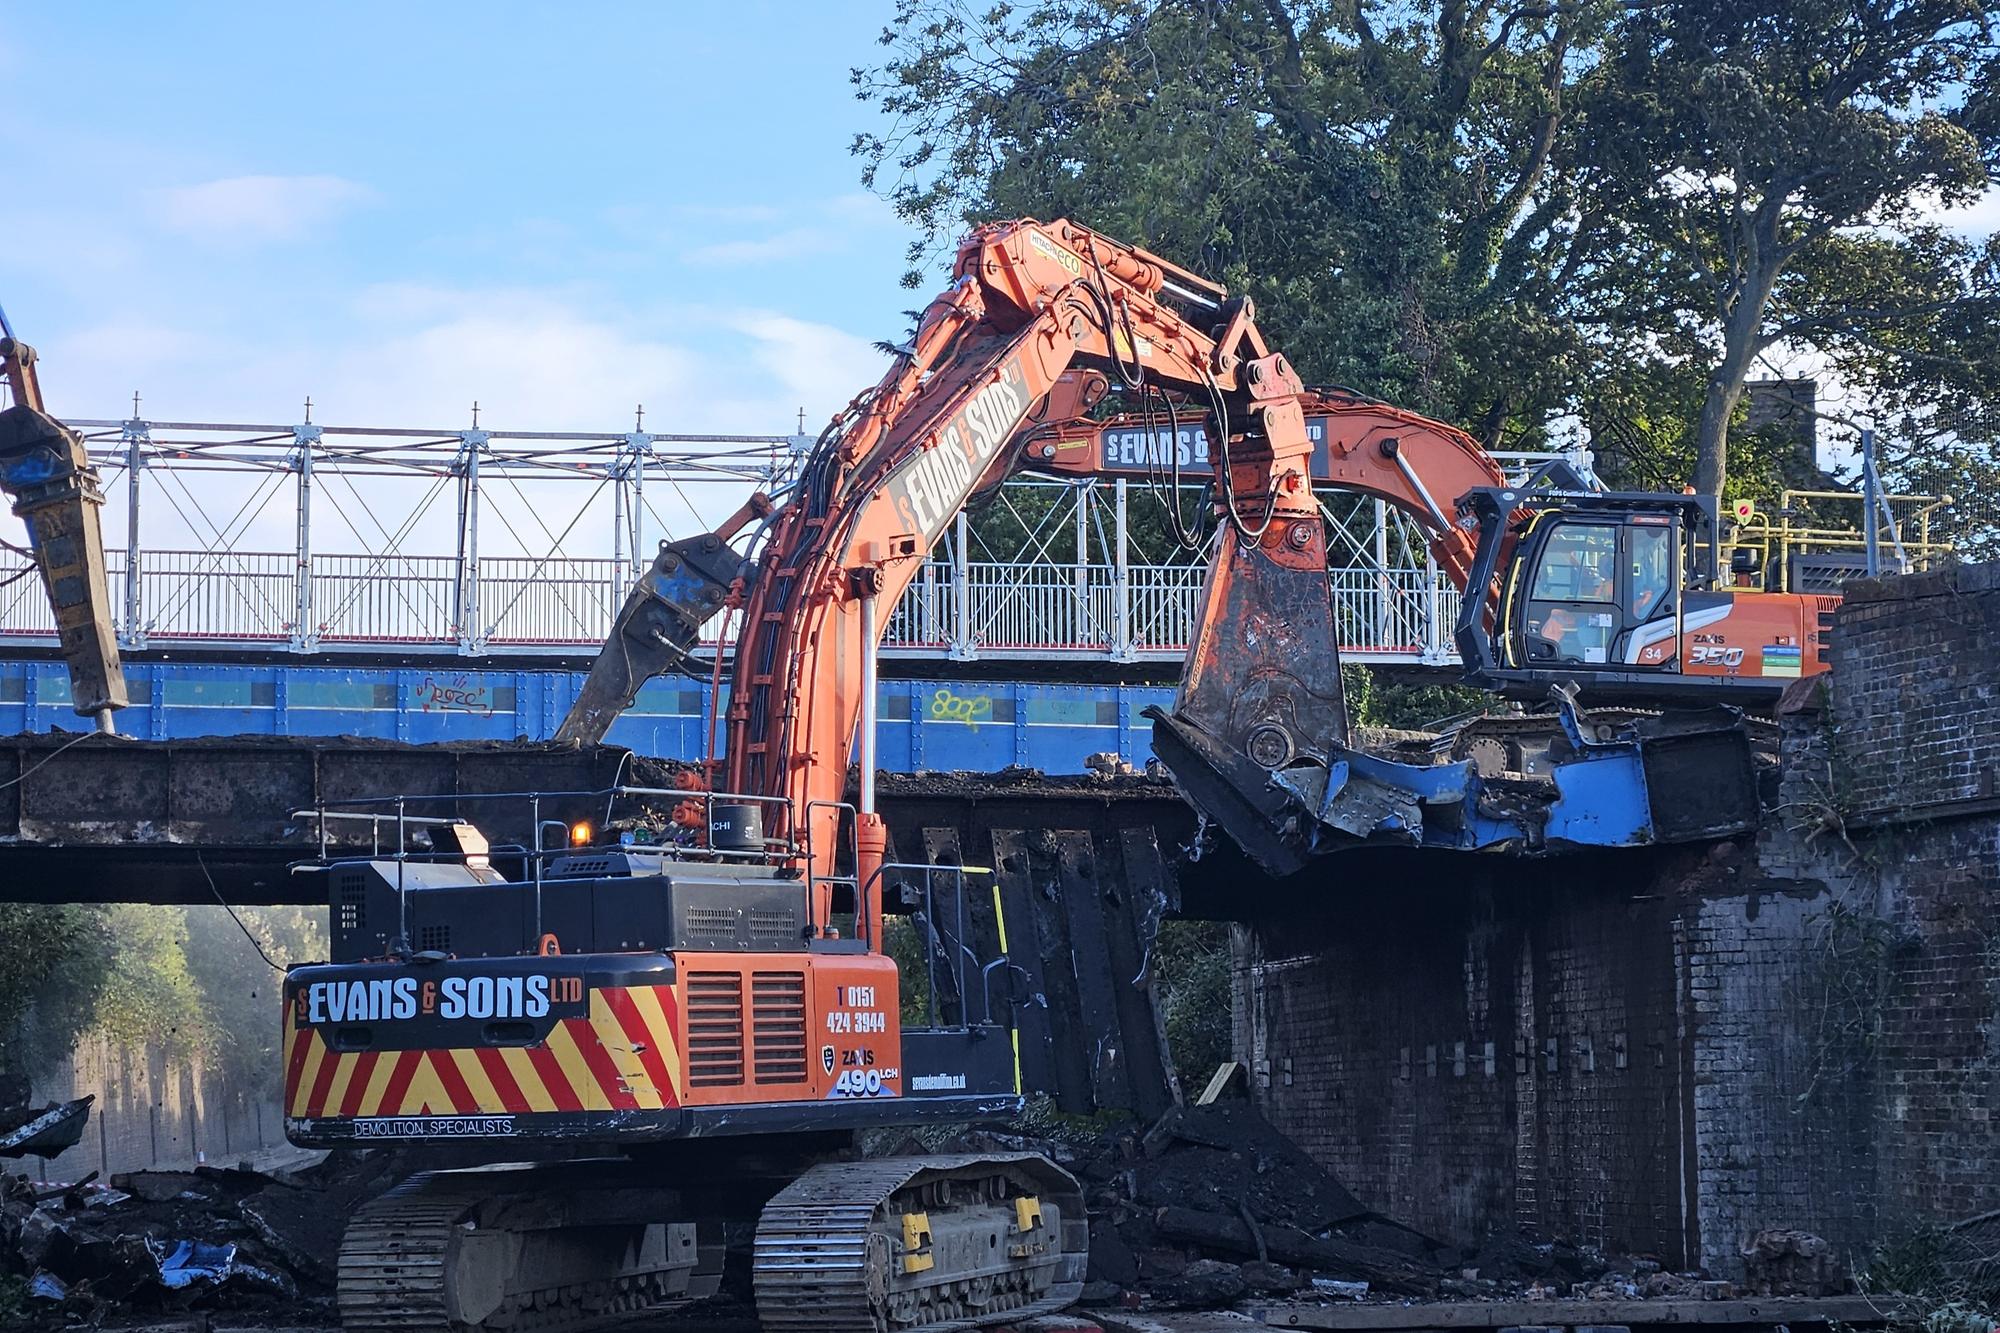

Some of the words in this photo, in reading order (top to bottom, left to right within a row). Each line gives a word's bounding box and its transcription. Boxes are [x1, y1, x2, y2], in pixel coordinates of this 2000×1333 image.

[905, 426, 971, 536] EVANS
[965, 368, 1021, 459] SONS
[1120, 431, 1190, 466] EVANS
[1305, 425, 1322, 440] TD
[1694, 633, 1725, 644] ZAXIS
[1645, 648, 1662, 660] 34
[1688, 646, 1744, 667] 350
[308, 977, 418, 1023] EVANS
[422, 981, 436, 1014] &
[440, 974, 550, 1019] SONS
[550, 977, 583, 1003] LTD
[848, 986, 875, 1008] 0151
[826, 1012, 851, 1034] 424
[854, 1012, 885, 1033] 3944
[842, 1047, 875, 1066] ZAXIS
[836, 1069, 882, 1096] 490
[880, 1068, 899, 1080] LCH
[354, 1121, 424, 1136] DEMOLITION
[430, 1119, 513, 1134] SPECIALISTS
